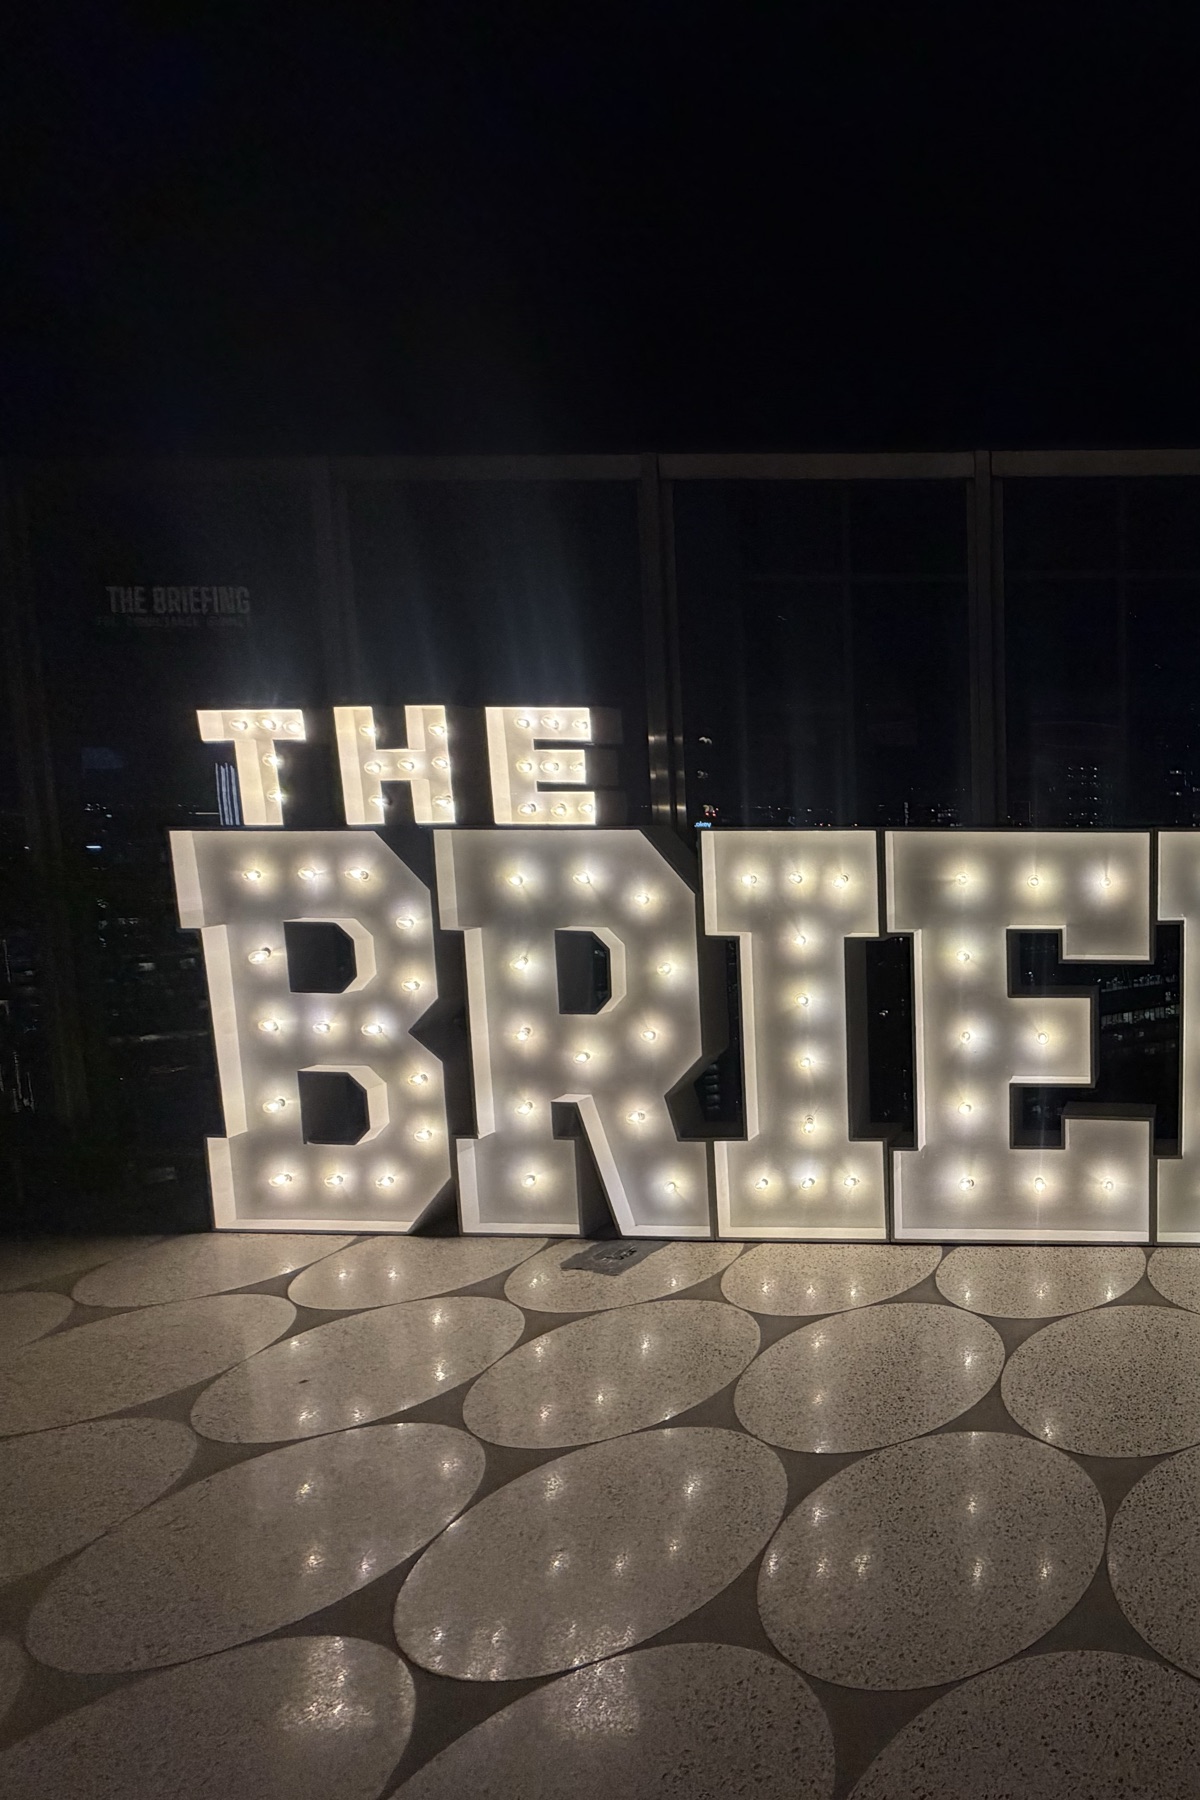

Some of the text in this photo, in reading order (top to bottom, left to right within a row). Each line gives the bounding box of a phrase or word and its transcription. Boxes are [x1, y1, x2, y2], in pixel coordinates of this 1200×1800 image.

[105, 586, 250, 614] THE BRIEFING
[196, 705, 596, 825] THE
